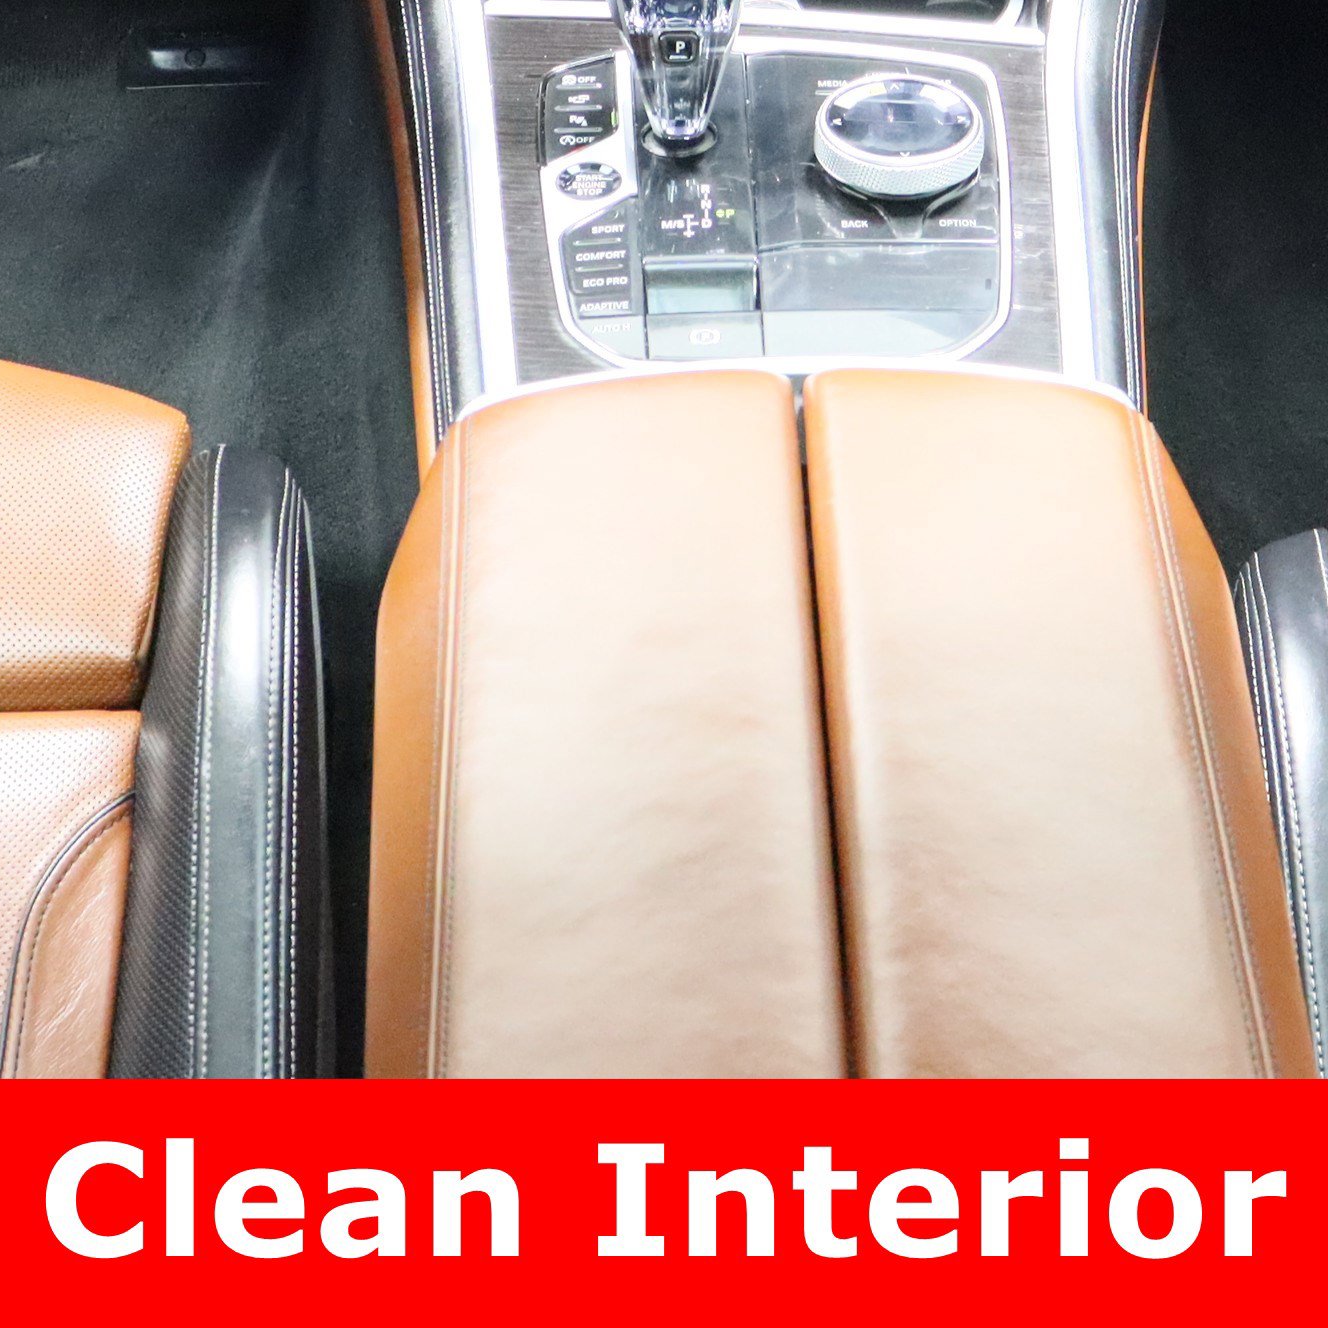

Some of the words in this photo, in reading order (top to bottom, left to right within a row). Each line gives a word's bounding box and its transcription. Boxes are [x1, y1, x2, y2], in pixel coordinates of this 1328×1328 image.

[675, 41, 686, 54] P
[577, 76, 597, 84] OFF
[572, 181, 607, 189] ENGINE
[576, 188, 603, 196] STOP
[700, 199, 712, 209] N
[701, 218, 712, 228] D
[841, 219, 869, 228] BACK
[939, 218, 977, 227] OPTION
[591, 224, 625, 235] SPORT
[575, 250, 626, 262] COMFORT
[582, 277, 604, 288] ECO
[606, 276, 628, 287] PRO
[579, 300, 629, 312] ADAPTIVE
[591, 324, 620, 334] AUTO
